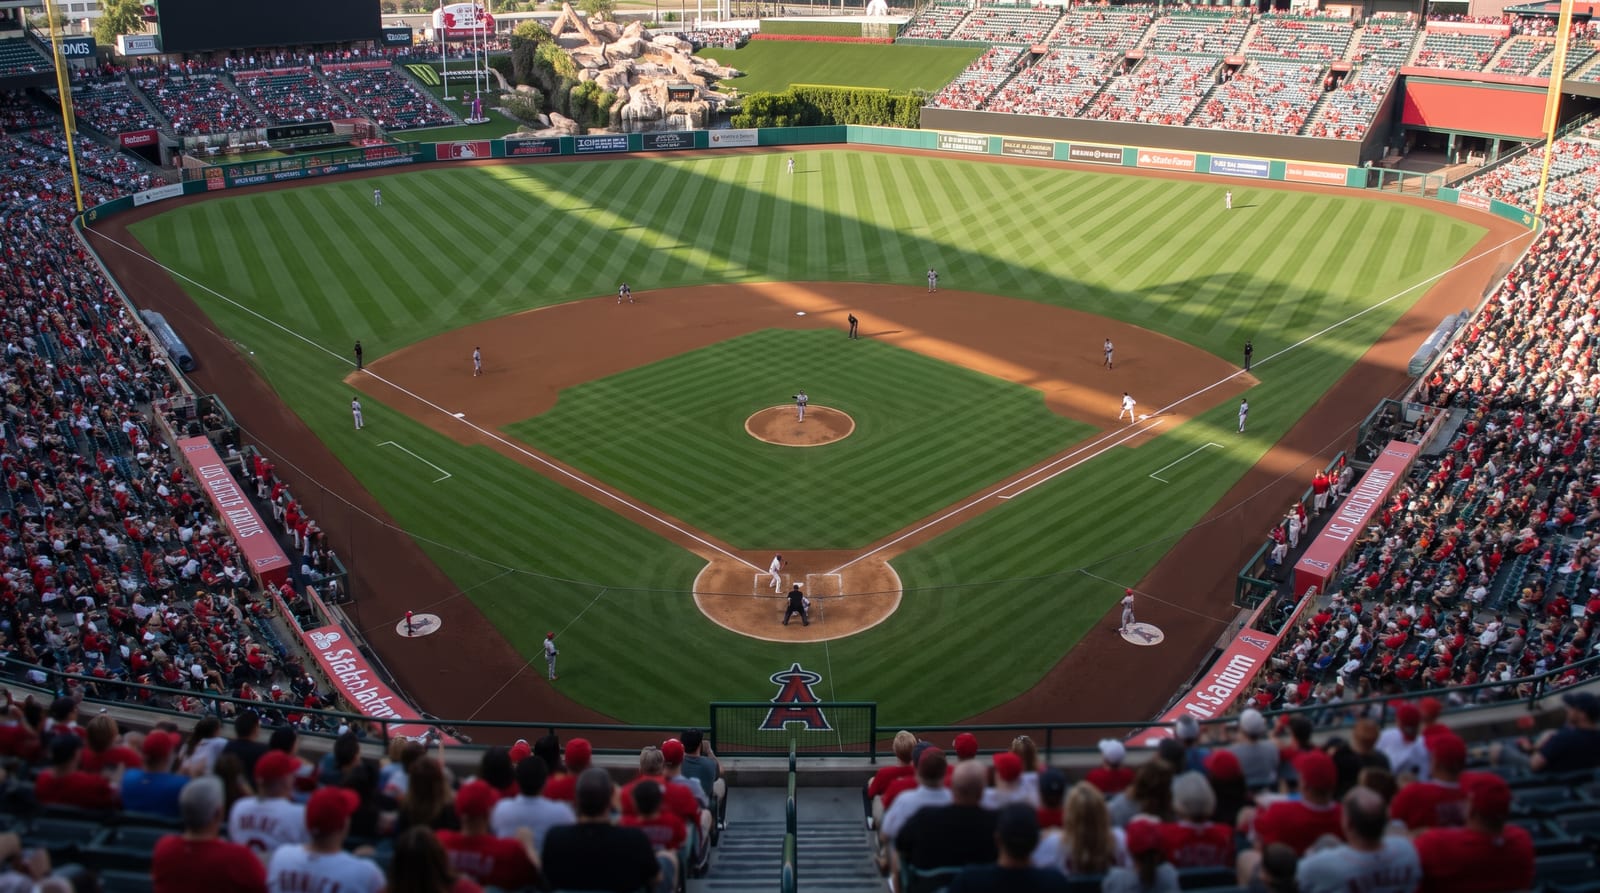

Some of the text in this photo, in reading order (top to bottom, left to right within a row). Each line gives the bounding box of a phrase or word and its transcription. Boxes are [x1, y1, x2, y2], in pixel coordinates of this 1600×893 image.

[1151, 155, 1194, 167] State Farm
[757, 662, 834, 731] A
